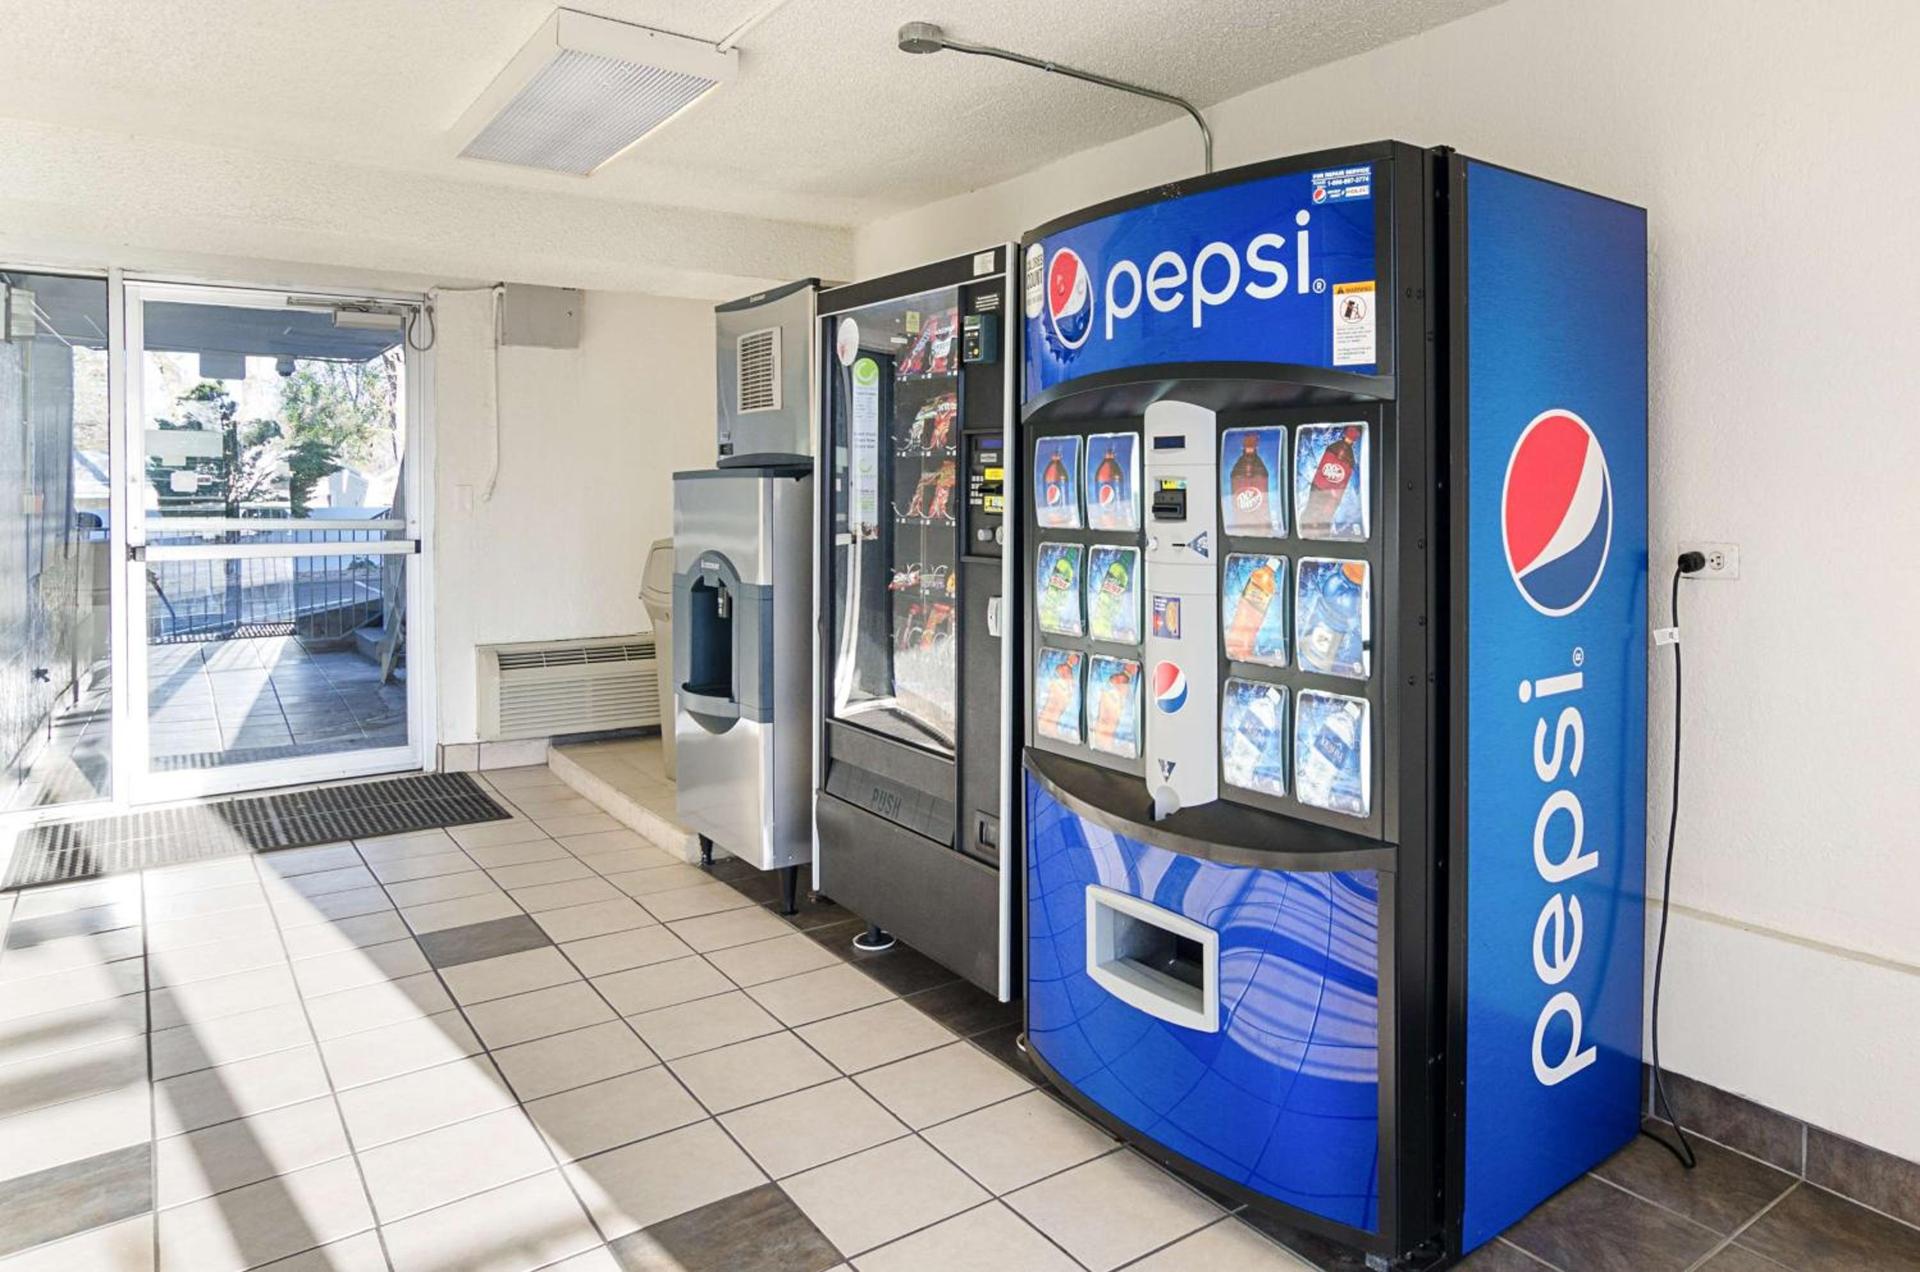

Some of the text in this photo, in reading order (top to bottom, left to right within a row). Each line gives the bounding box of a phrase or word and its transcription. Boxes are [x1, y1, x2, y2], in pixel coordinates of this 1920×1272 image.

[1106, 209, 1310, 340] pepsi
[872, 787, 902, 819] PUSH
[1518, 672, 1599, 1087] pepsi
